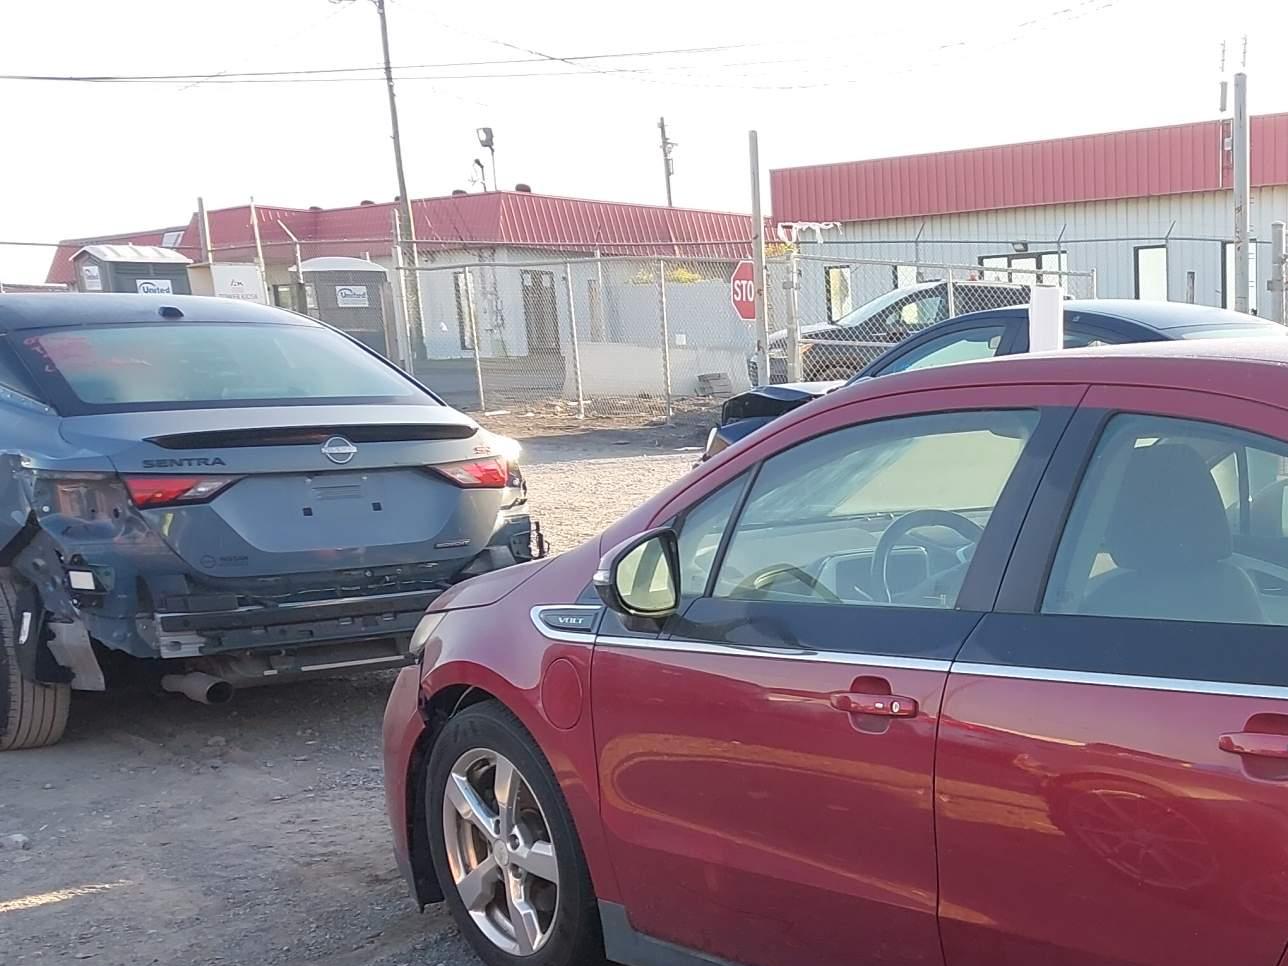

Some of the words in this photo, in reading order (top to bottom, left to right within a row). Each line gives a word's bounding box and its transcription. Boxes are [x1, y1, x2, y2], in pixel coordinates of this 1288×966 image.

[142, 285, 171, 294] United
[733, 280, 755, 302] STO
[143, 457, 226, 469] SENTRA
[558, 615, 585, 624] VOLT
